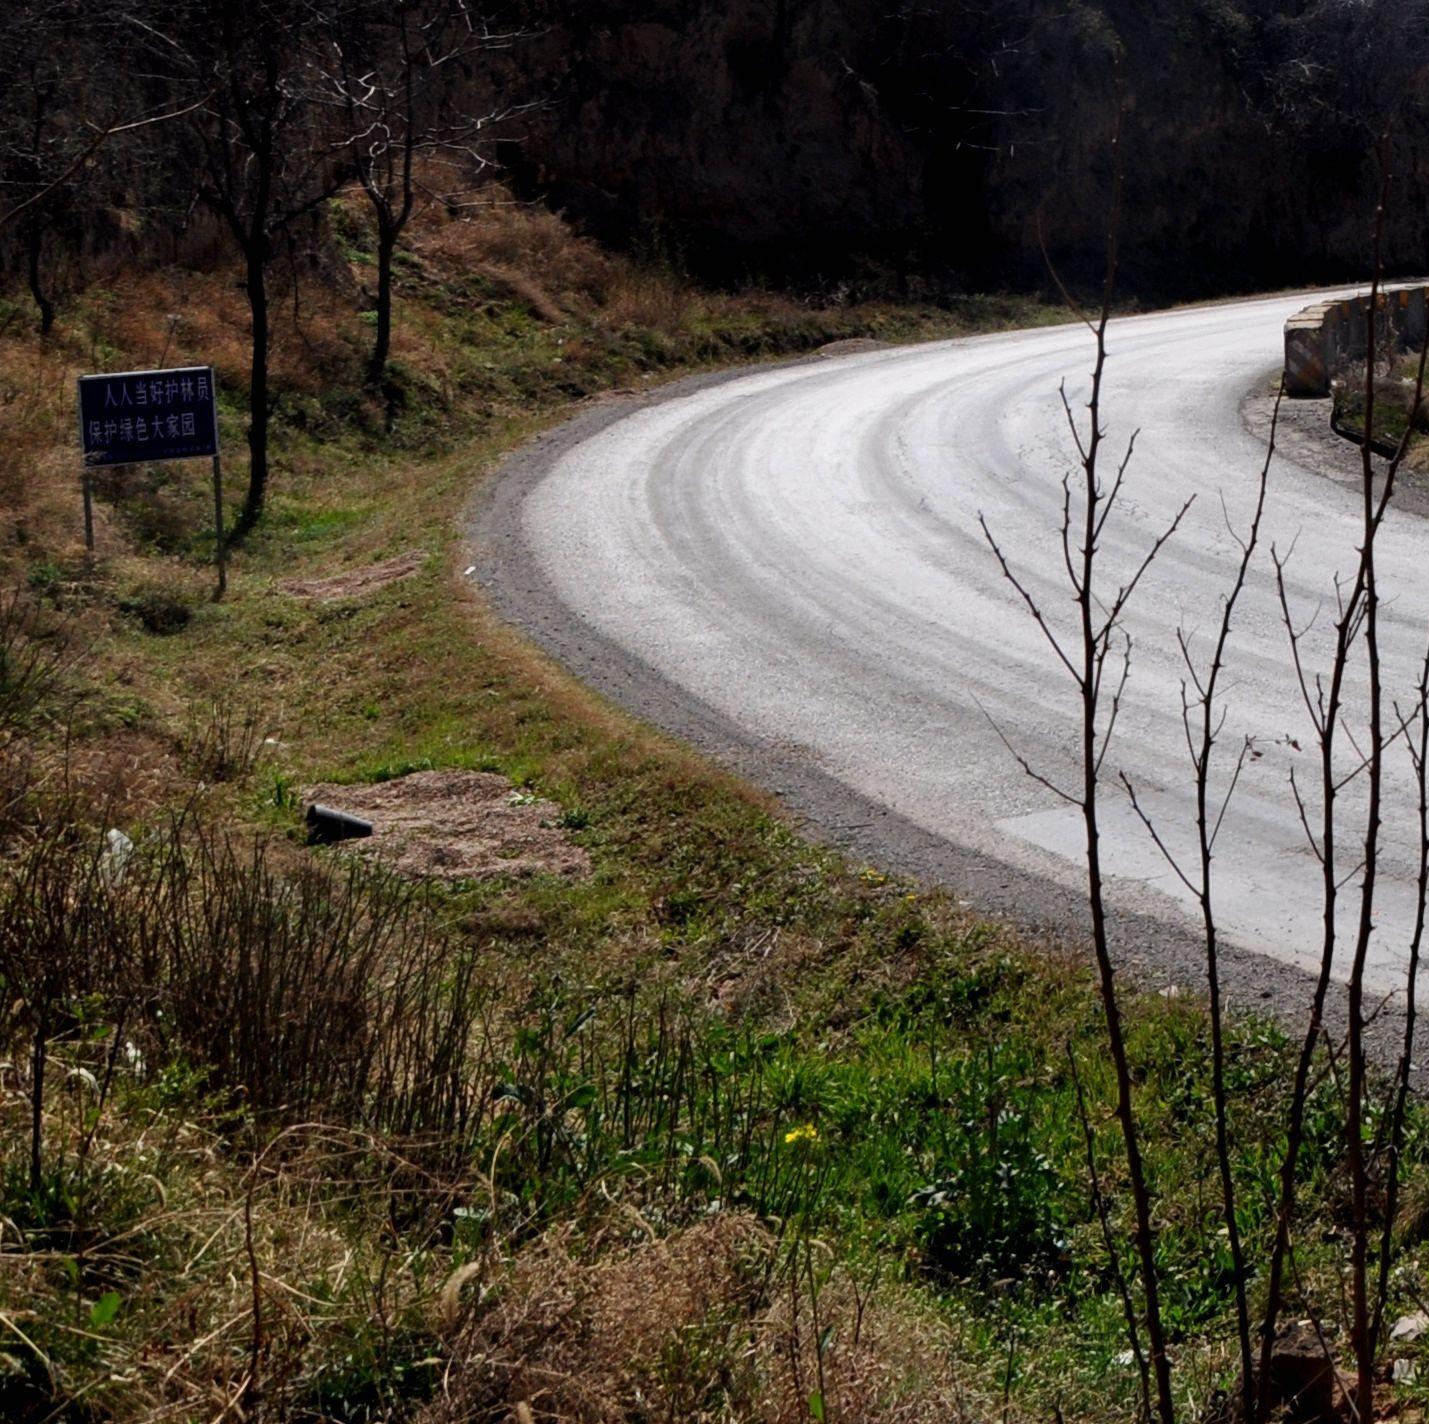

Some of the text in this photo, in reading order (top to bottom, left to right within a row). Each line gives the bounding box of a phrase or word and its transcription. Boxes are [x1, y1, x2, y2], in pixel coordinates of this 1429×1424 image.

[104, 376, 210, 407] 人人当好护林员
[88, 412, 196, 445] 保护绿色大家园
